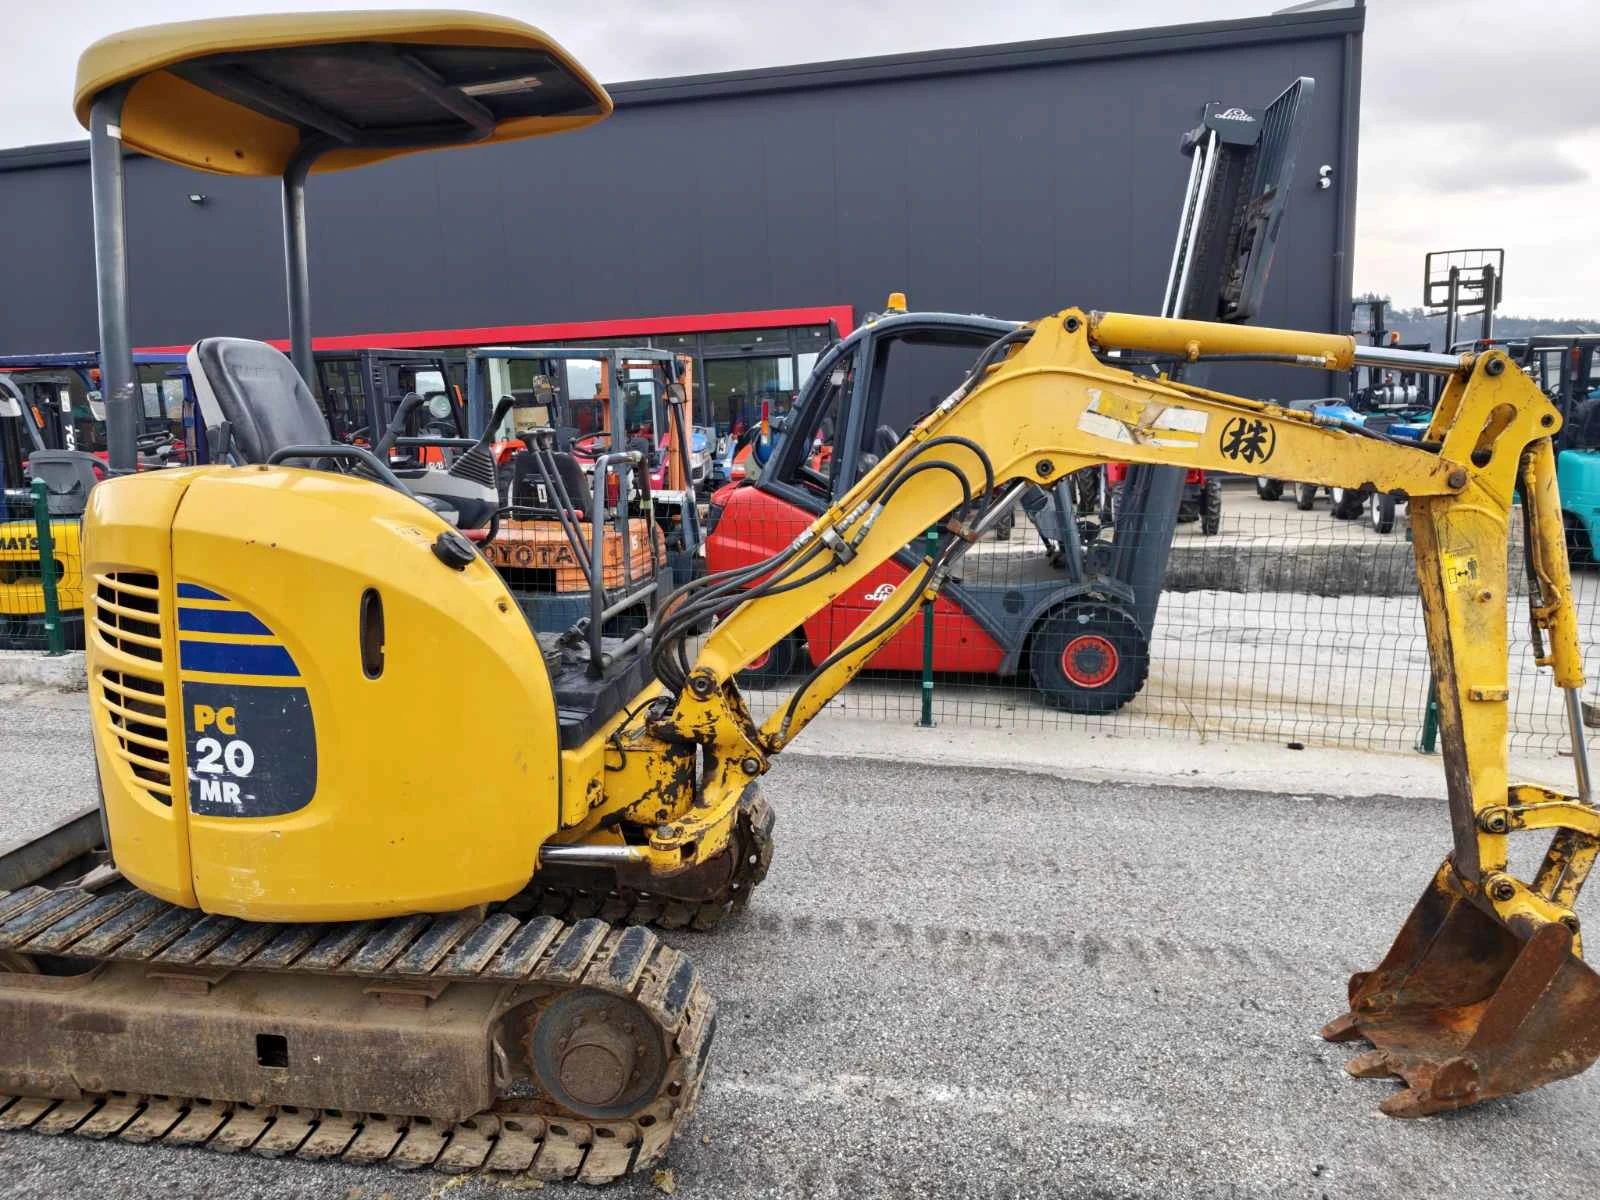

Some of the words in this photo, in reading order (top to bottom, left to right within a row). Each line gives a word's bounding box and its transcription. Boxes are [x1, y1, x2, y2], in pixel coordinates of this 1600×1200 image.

[1214, 107, 1257, 122] Linde
[194, 704, 236, 735] PC
[195, 737, 254, 778] 20
[199, 779, 243, 805] MR
